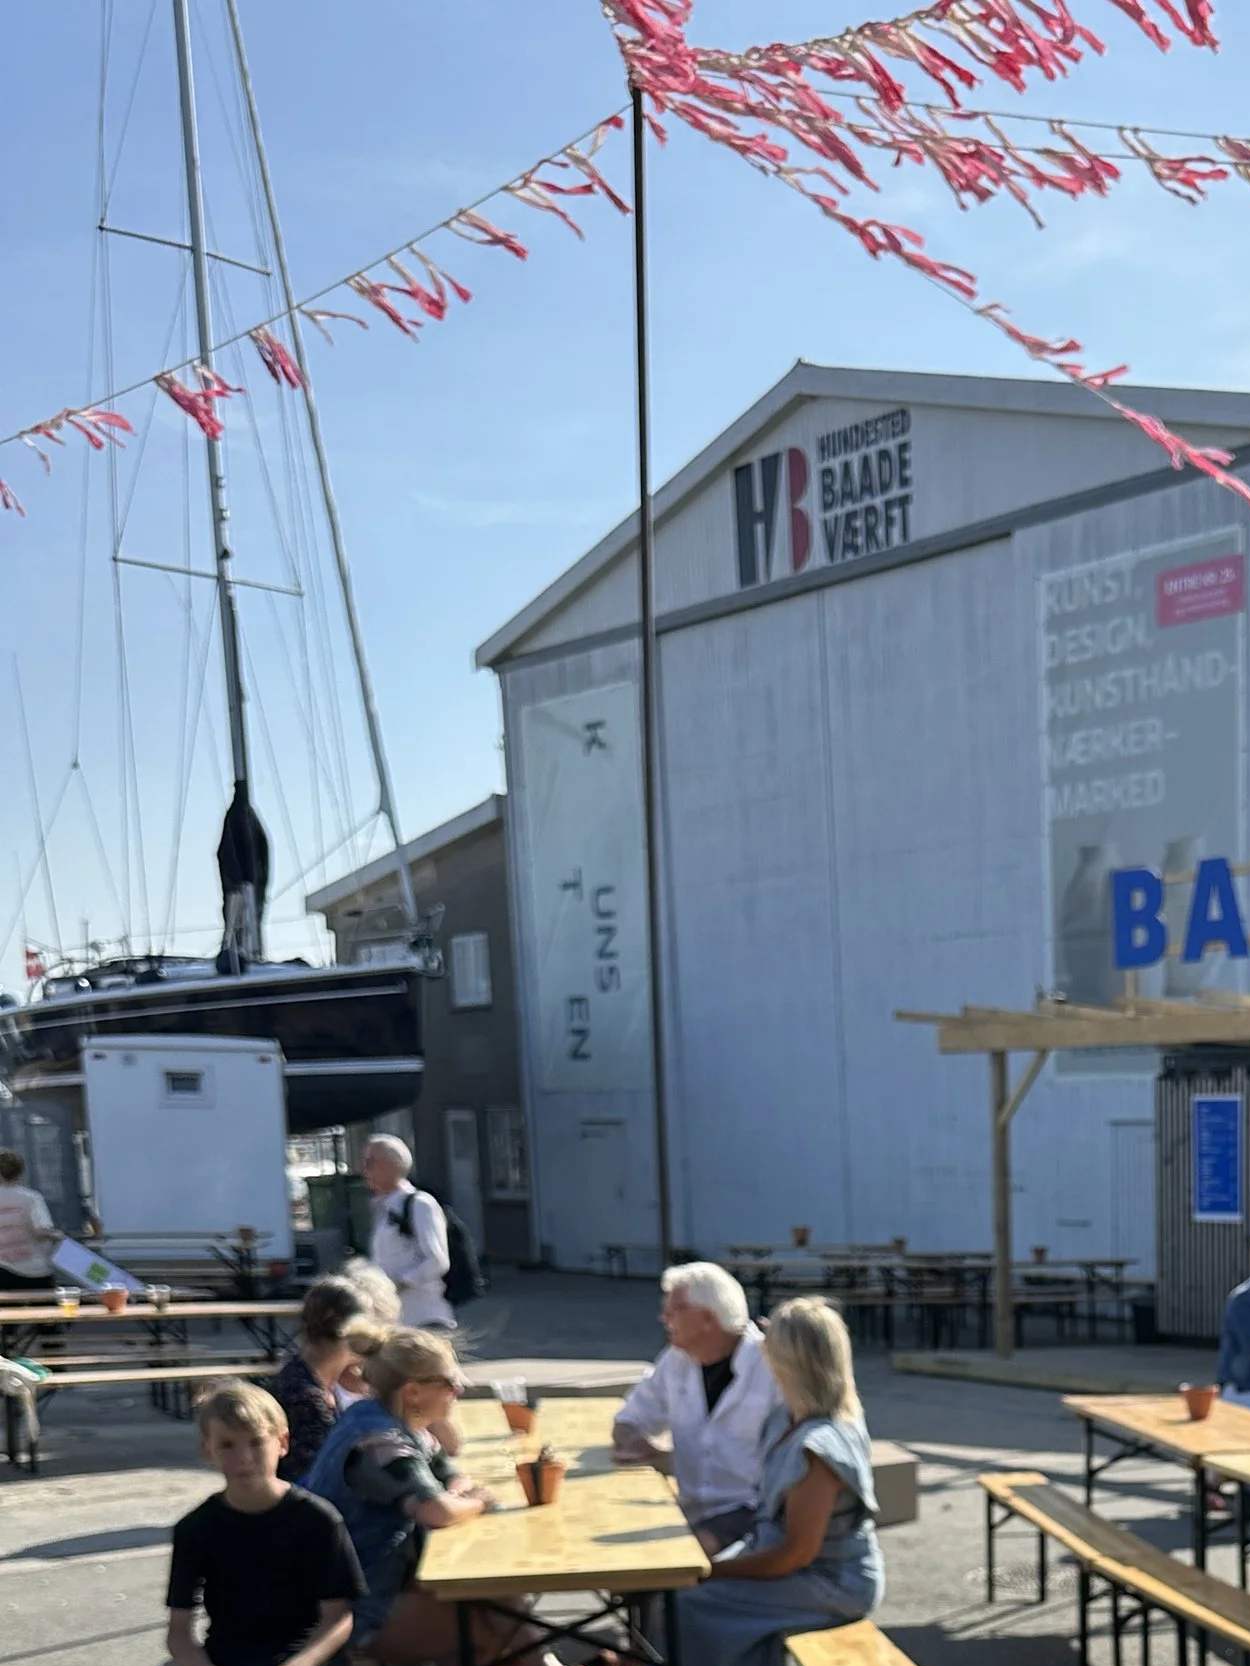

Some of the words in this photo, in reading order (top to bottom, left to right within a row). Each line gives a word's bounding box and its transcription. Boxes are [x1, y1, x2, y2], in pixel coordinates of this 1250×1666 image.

[817, 408, 912, 462] HUNDESTED
[821, 441, 913, 513] BAADE
[823, 494, 913, 563] VÆRFT
